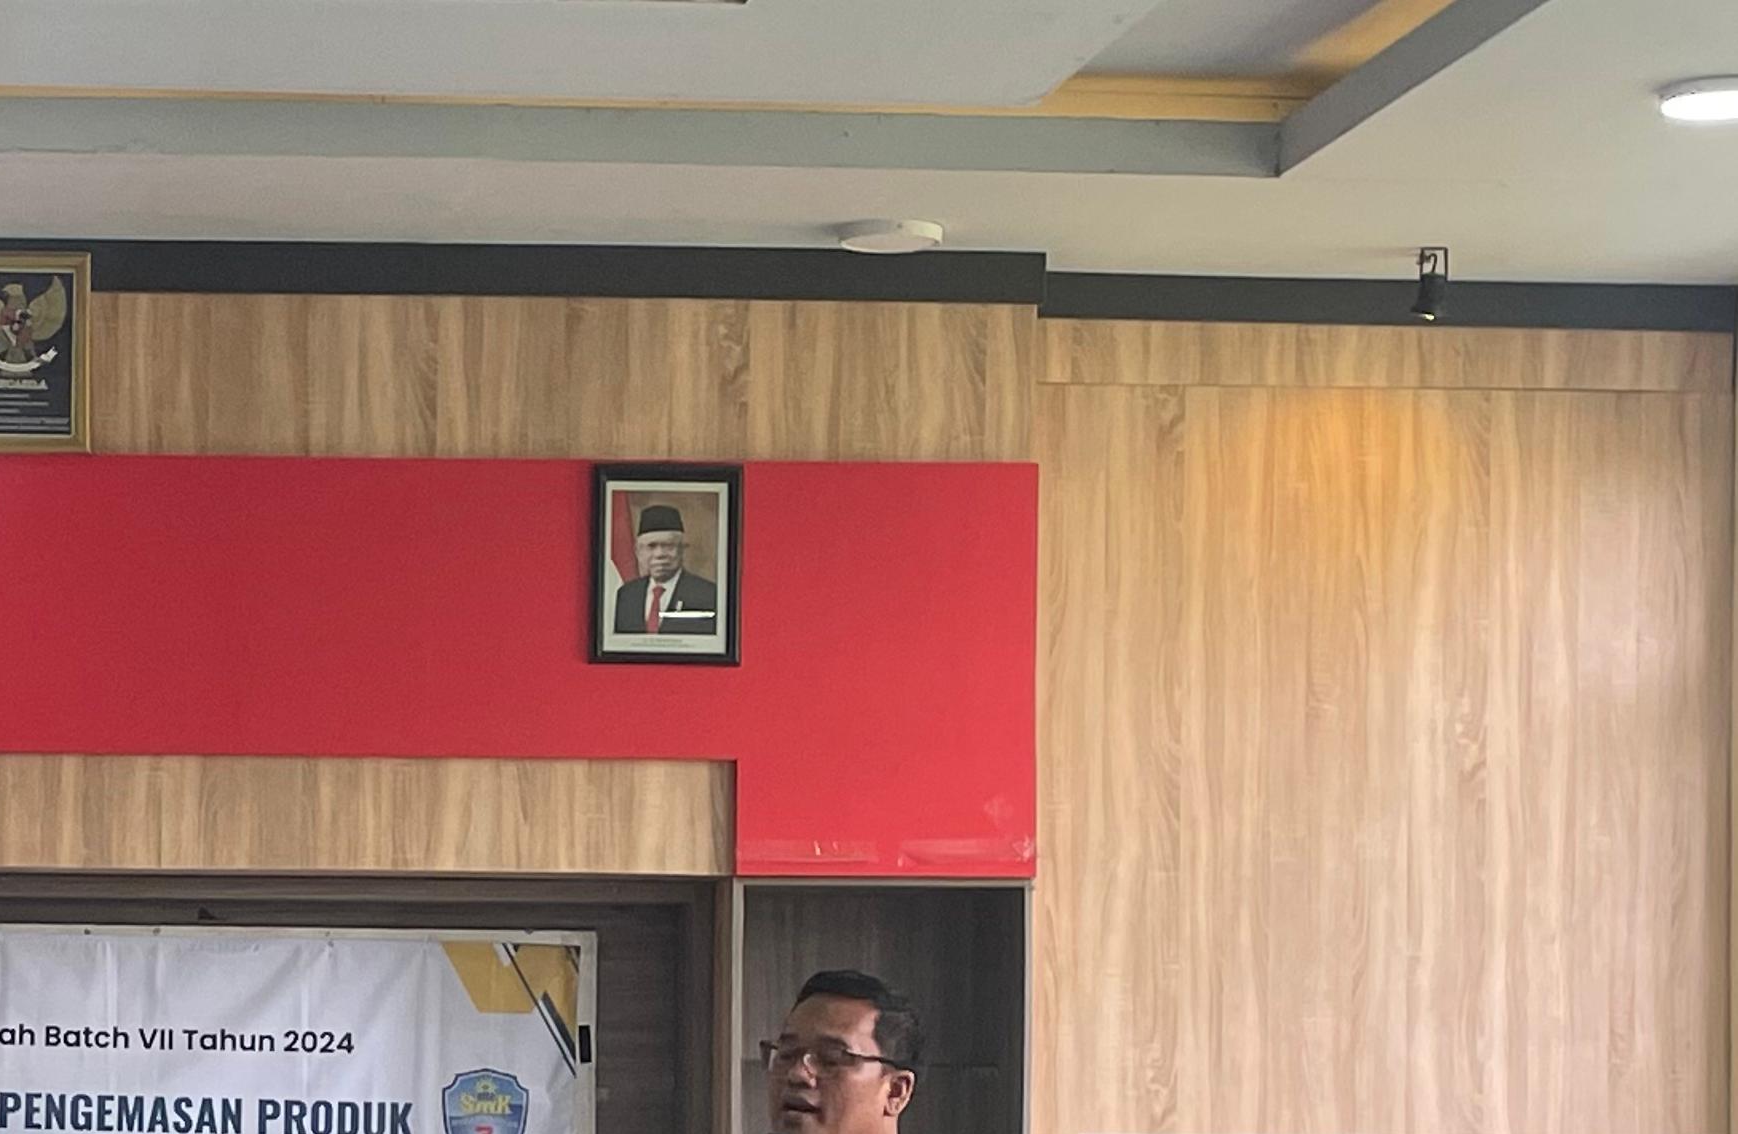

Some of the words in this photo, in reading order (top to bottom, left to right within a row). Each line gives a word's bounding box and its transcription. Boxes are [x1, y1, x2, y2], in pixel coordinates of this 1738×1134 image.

[44, 1025, 130, 1049] Batch
[138, 1028, 174, 1051] VII
[181, 1028, 276, 1052] Tahun
[283, 1030, 355, 1055] 2024
